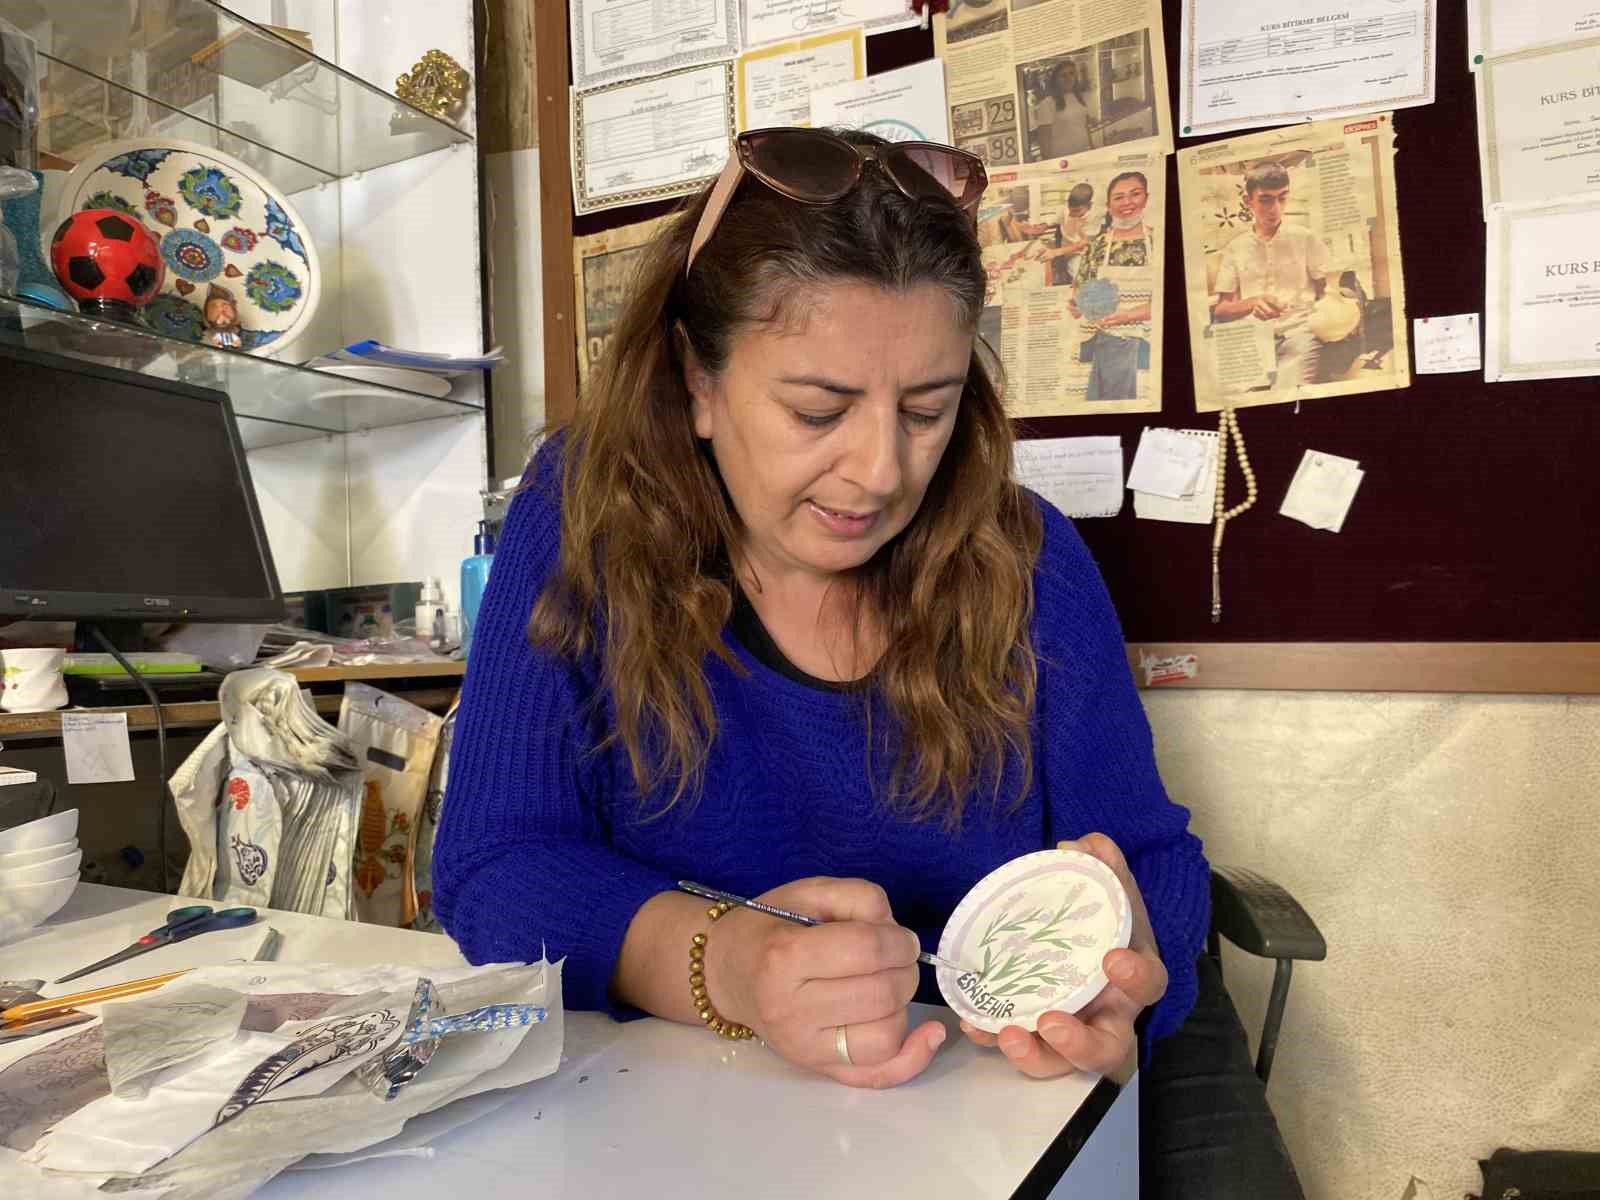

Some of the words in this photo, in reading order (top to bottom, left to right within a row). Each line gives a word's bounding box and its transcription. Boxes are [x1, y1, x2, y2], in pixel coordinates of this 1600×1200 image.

[1540, 90, 1577, 105] KURS
[990, 100, 1015, 125] 29
[991, 136, 1017, 161] 98
[1545, 262, 1589, 277] KURS
